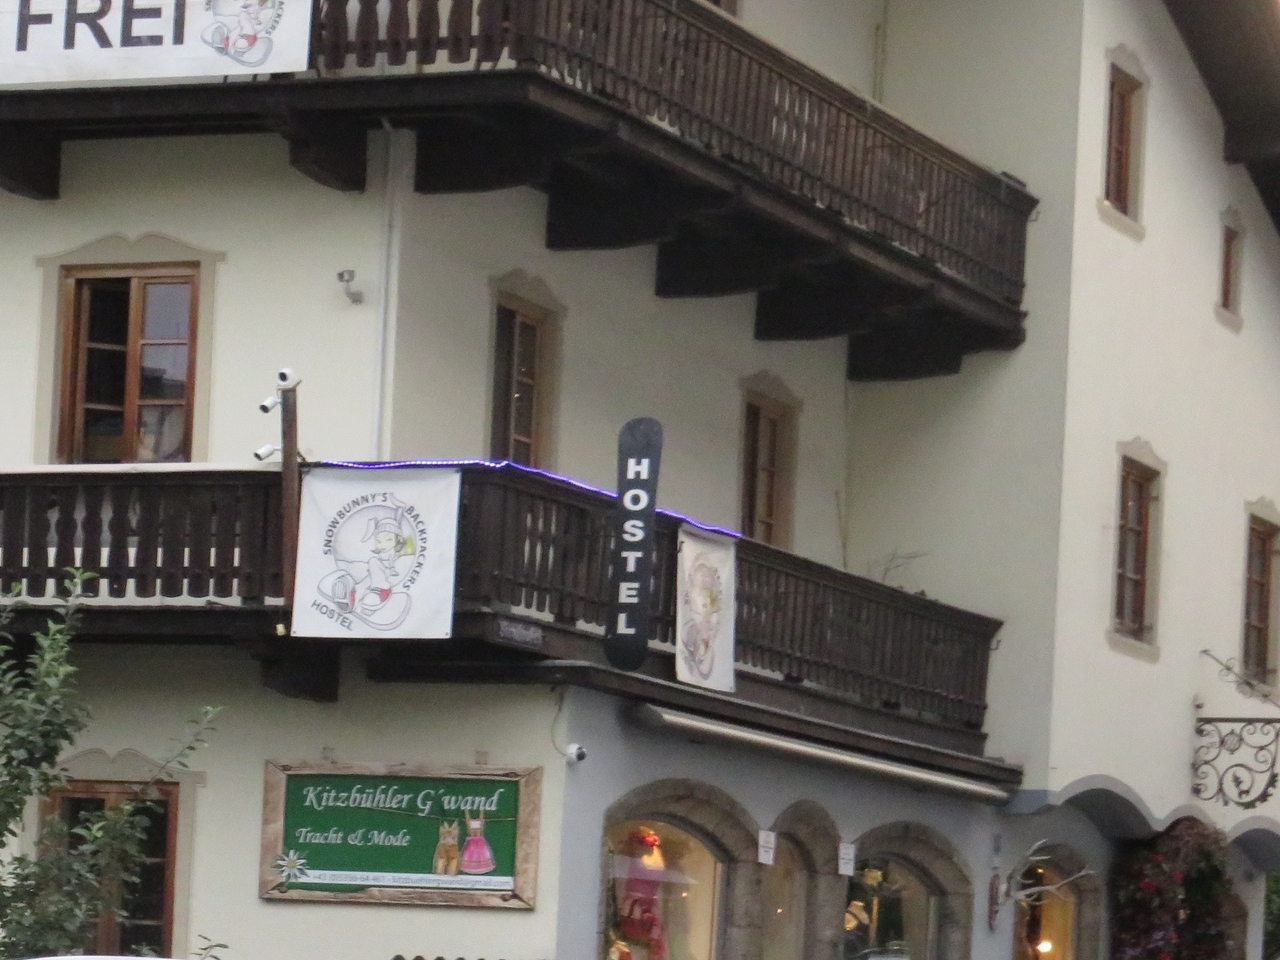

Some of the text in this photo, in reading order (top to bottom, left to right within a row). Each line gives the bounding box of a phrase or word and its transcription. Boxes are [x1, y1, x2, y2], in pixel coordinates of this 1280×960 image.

[15, 0, 186, 51] FREI
[323, 492, 428, 591] SNOWBUNNY'S BACKPACKERS
[617, 458, 649, 635] HOSTEL
[310, 599, 354, 632] HOSTEL
[303, 785, 413, 810] Kitzbühler
[295, 827, 411, 846] Tracht & Mode
